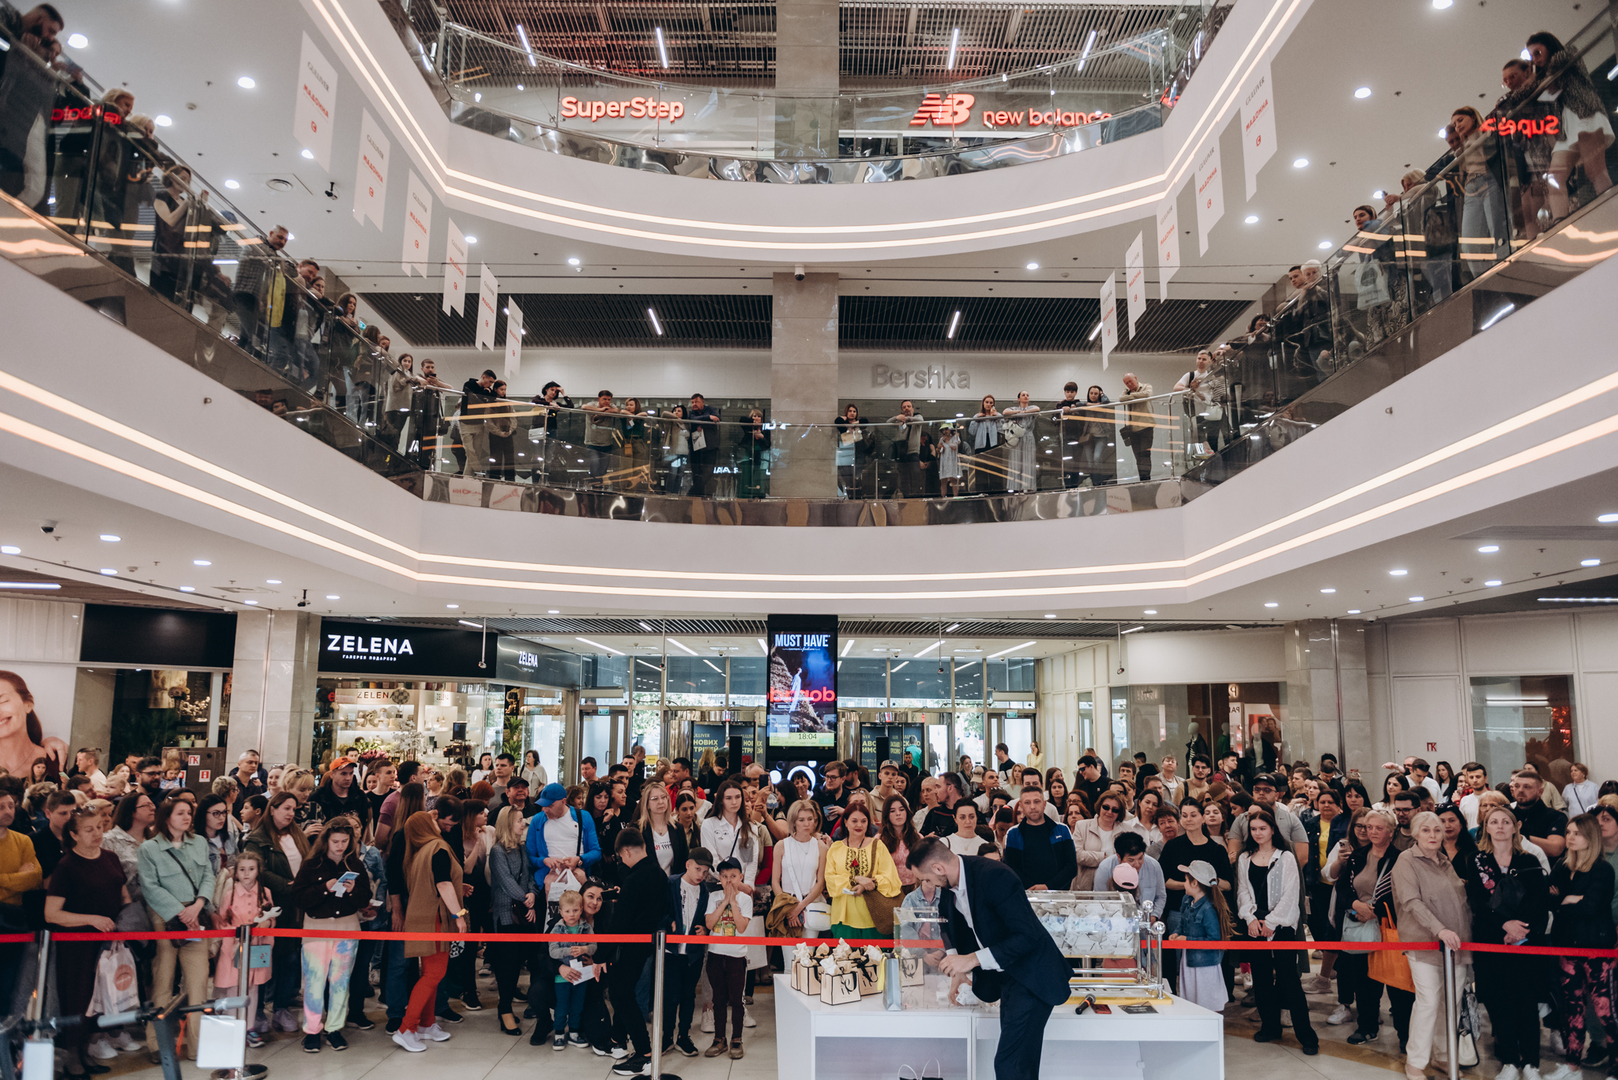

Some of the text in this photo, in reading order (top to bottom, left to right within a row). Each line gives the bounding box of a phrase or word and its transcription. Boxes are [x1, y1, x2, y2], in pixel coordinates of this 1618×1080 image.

[560, 96, 685, 123] SuperStep
[982, 110, 1025, 127] new
[870, 364, 971, 389] Bershka
[327, 634, 414, 655] ZELENA
[774, 634, 802, 647] MUST
[518, 650, 539, 668] ZELENA
[1426, 742, 1437, 752] ПК
[188, 755, 199, 765] ПК
